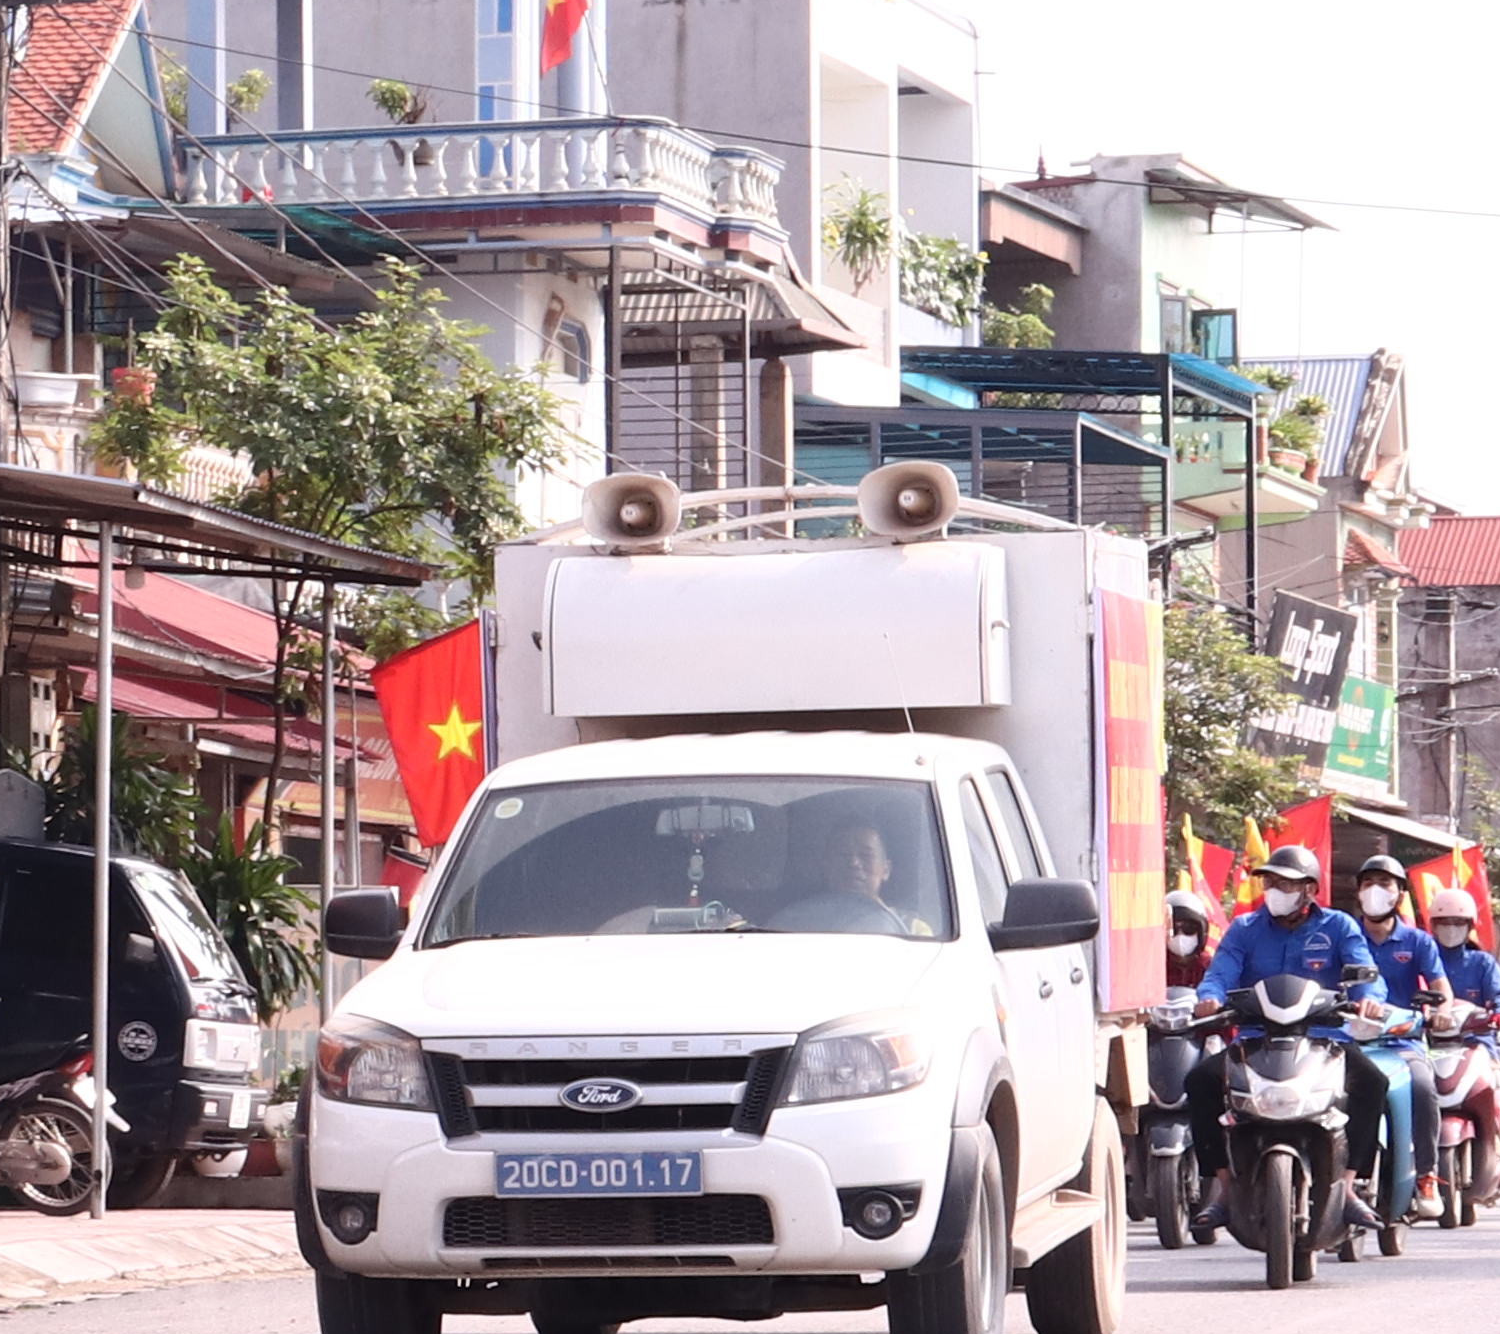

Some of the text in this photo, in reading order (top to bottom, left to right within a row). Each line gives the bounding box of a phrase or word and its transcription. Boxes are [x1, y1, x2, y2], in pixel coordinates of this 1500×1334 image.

[468, 1039, 743, 1055] RANGER
[577, 1083, 623, 1104] Ford
[503, 1158, 693, 1189] 20CD-001.17
